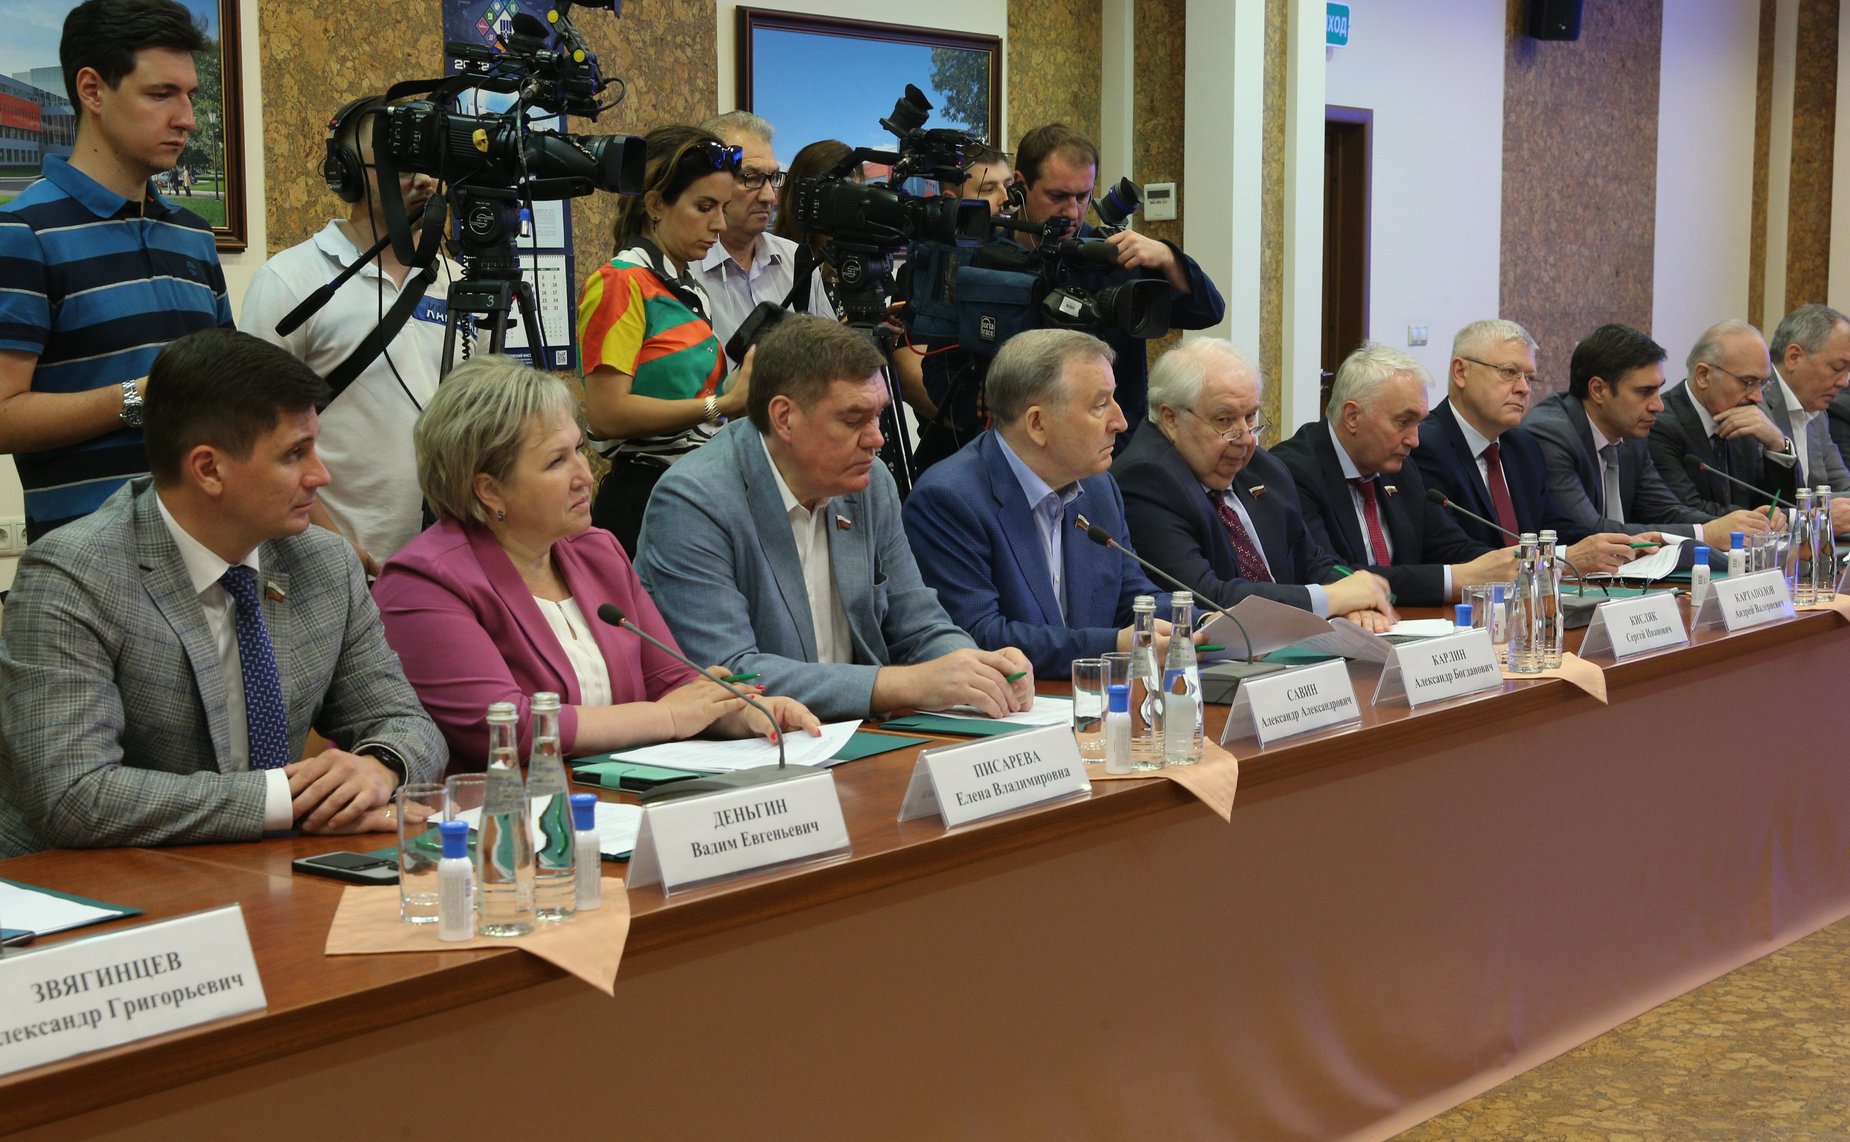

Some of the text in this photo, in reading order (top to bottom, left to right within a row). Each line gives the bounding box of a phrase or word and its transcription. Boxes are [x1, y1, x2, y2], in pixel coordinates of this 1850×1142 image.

[1326, 15, 1347, 37] ХОД
[486, 294, 495, 308] 3
[1734, 585, 1775, 603] КАРТАПОЛОВ
[1629, 611, 1658, 626] КИСЛЯК
[1735, 605, 1755, 619] Андрей
[1626, 625, 1673, 644] Сергей Иванович
[1432, 649, 1467, 666] КАРЛИН
[1415, 663, 1494, 688] Александр Богданович
[1286, 683, 1318, 701] САВИН
[1261, 696, 1352, 728] Александр Александрович
[973, 750, 1041, 778] ПИСАРЕВА
[956, 767, 1071, 806] Елена Владимировна
[713, 798, 788, 829] ДЕНЬГИН
[691, 821, 820, 858] Вадим Евгеньевич
[30, 951, 183, 1003] ЗВЯГИНЦЕВ
[0, 973, 244, 1047] лександр Григорьевич
